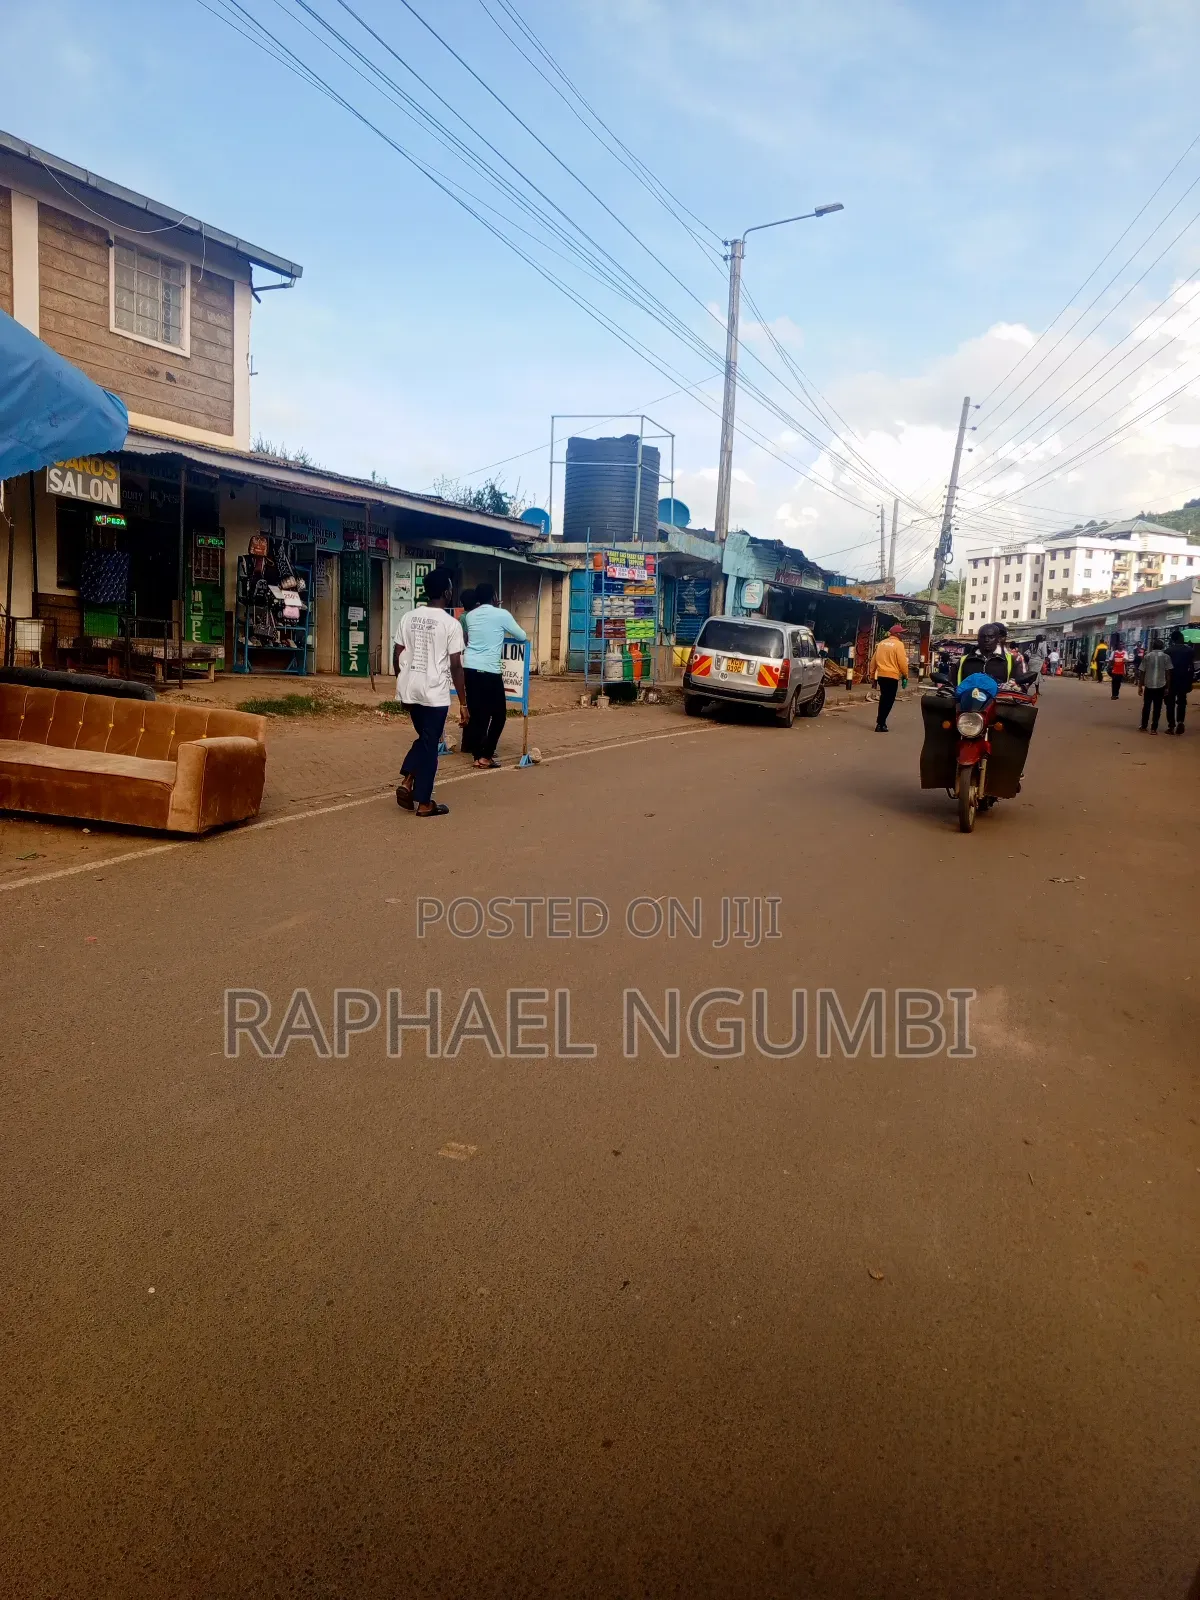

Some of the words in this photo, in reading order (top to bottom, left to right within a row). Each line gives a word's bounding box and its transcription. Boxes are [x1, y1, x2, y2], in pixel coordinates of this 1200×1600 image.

[54, 457, 117, 481] AROS
[49, 468, 119, 506] SALON
[501, 644, 525, 661] LON
[502, 670, 519, 679] UTEX,
